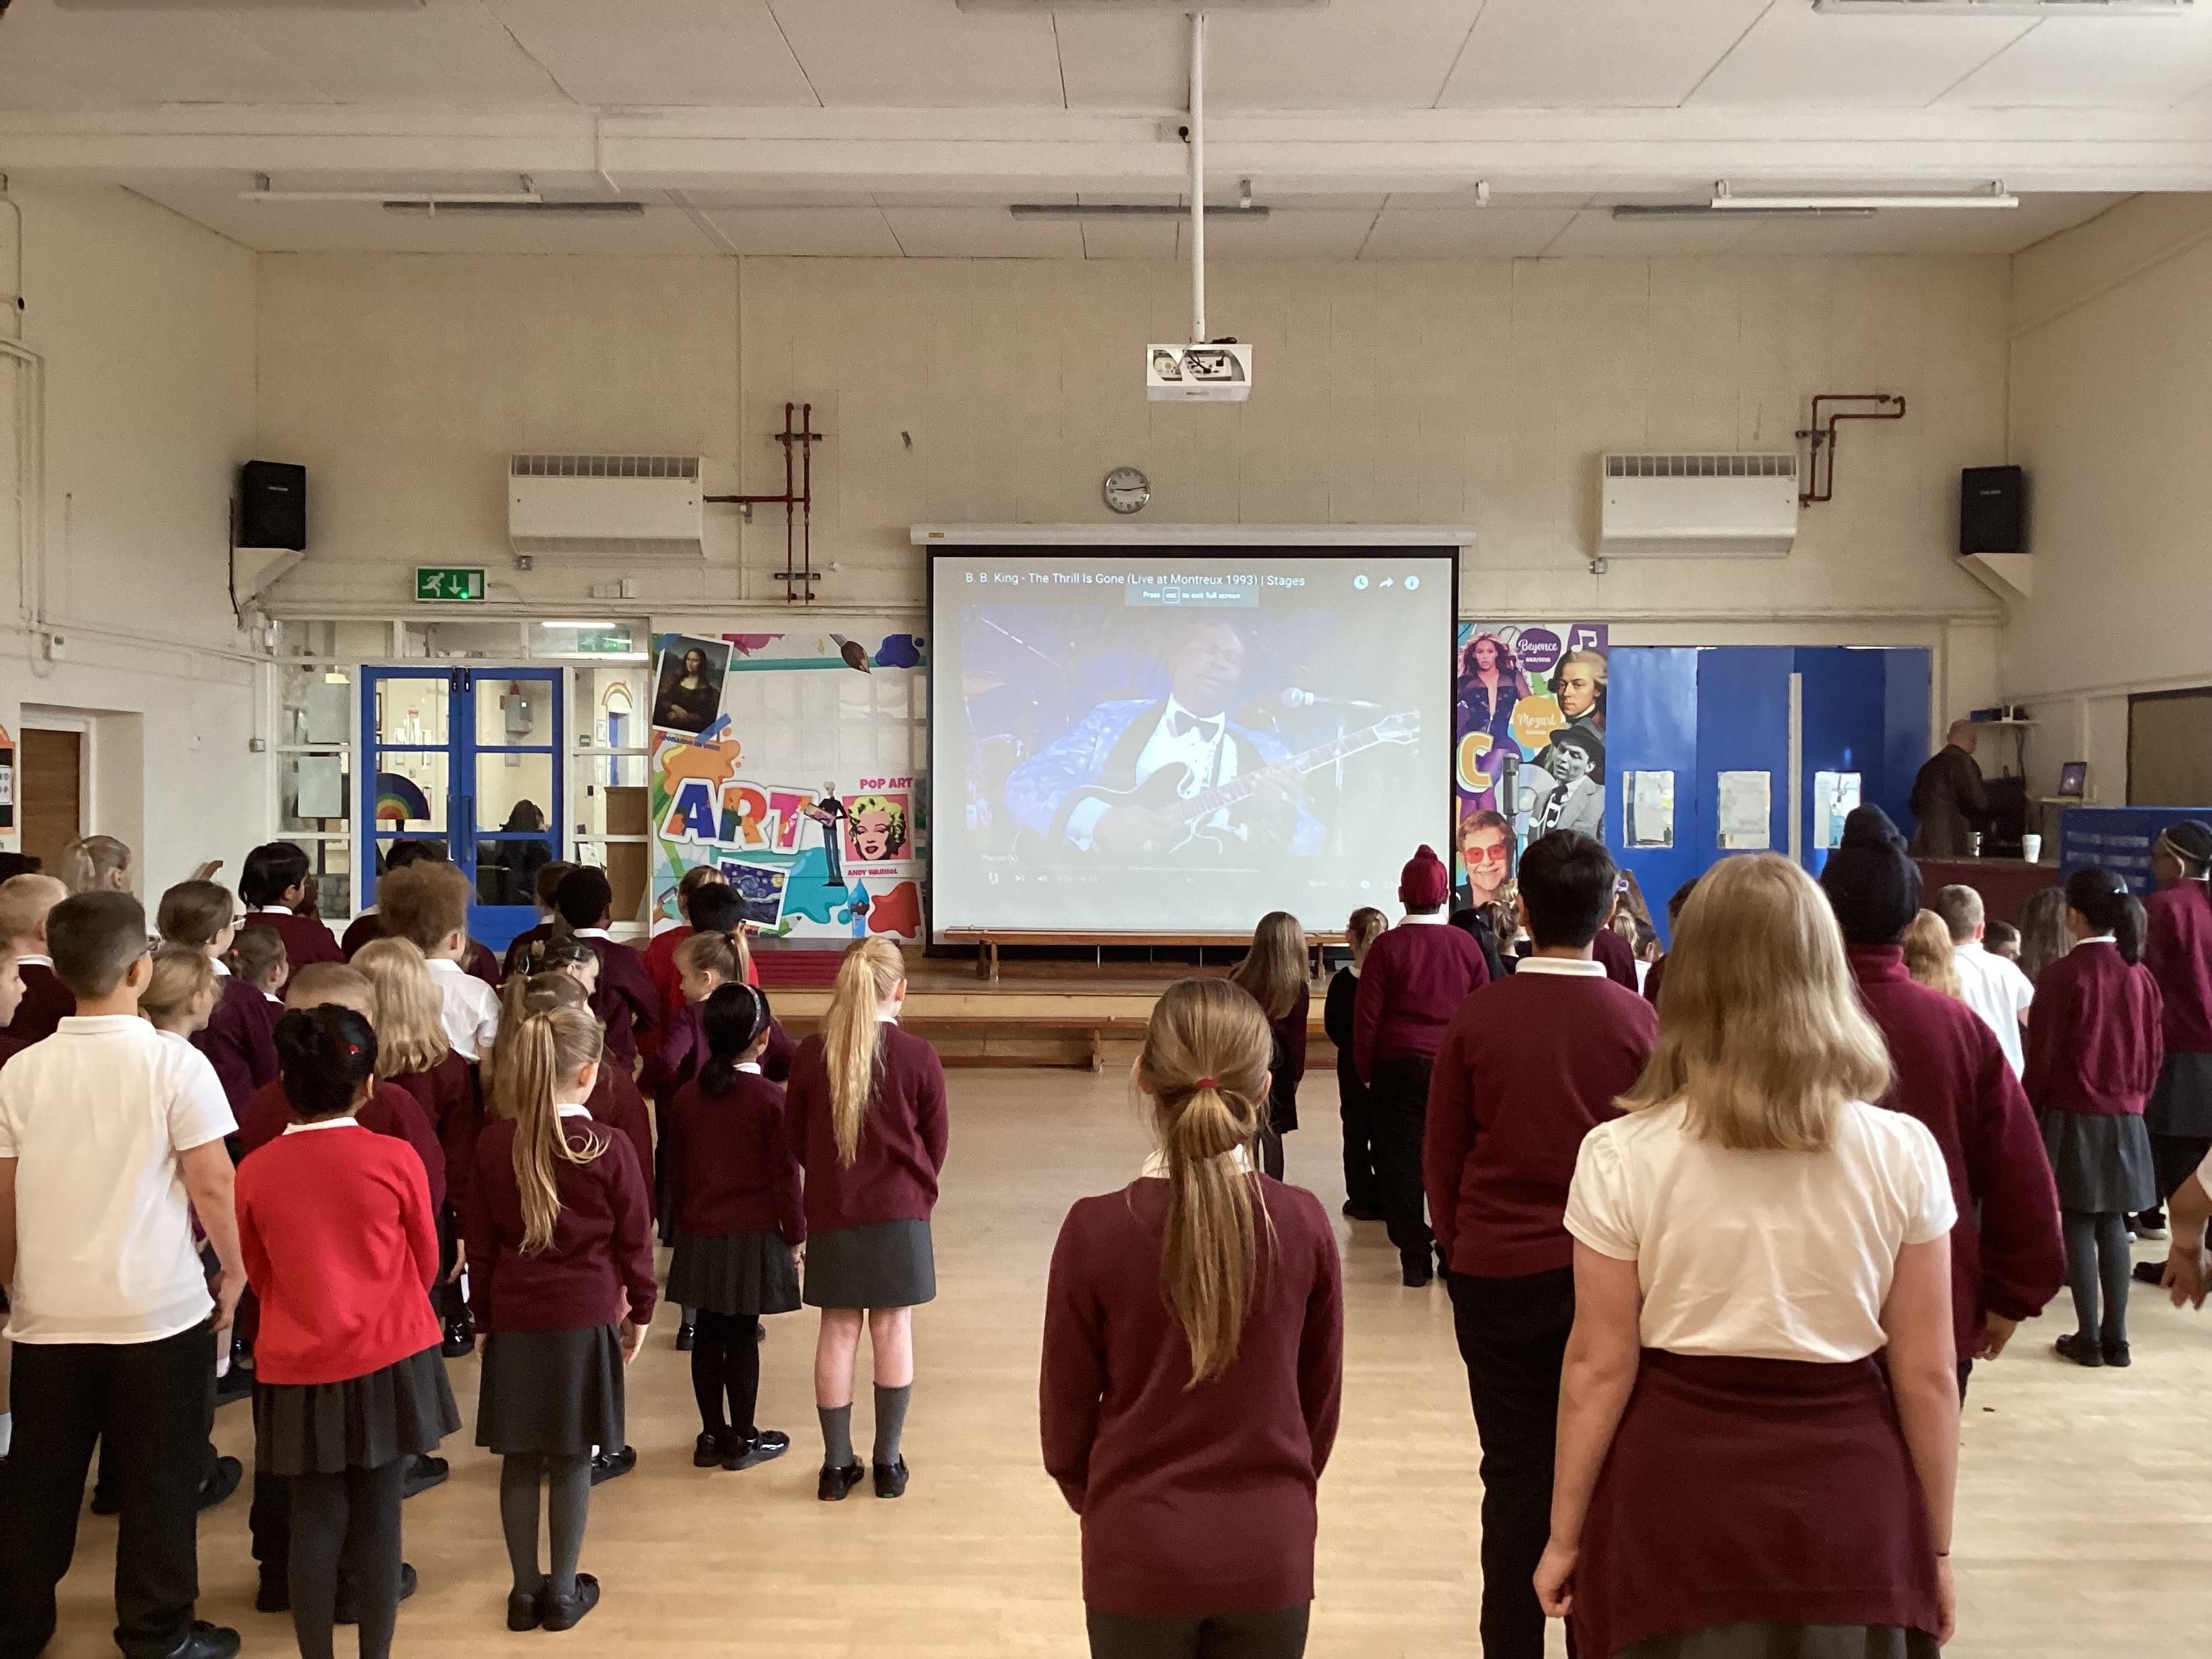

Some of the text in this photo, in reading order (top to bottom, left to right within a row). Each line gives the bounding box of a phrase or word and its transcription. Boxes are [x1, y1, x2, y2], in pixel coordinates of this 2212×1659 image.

[994, 573, 1019, 586] King
[1028, 573, 1049, 583] The
[1052, 573, 1080, 583] Thrill
[1083, 573, 1092, 583] Is
[1095, 573, 1124, 584] Gone
[1127, 573, 1153, 586] (Live
[1157, 575, 1168, 584] at
[1170, 574, 1223, 585] Montreux
[1227, 574, 1258, 586] 1993)
[1267, 575, 1305, 588] Stages
[1206, 591, 1217, 599] full
[1518, 639, 1558, 654] Beyonce
[1517, 712, 1557, 729] Mozart
[859, 777, 914, 790] POP ART
[663, 781, 815, 851] ART
